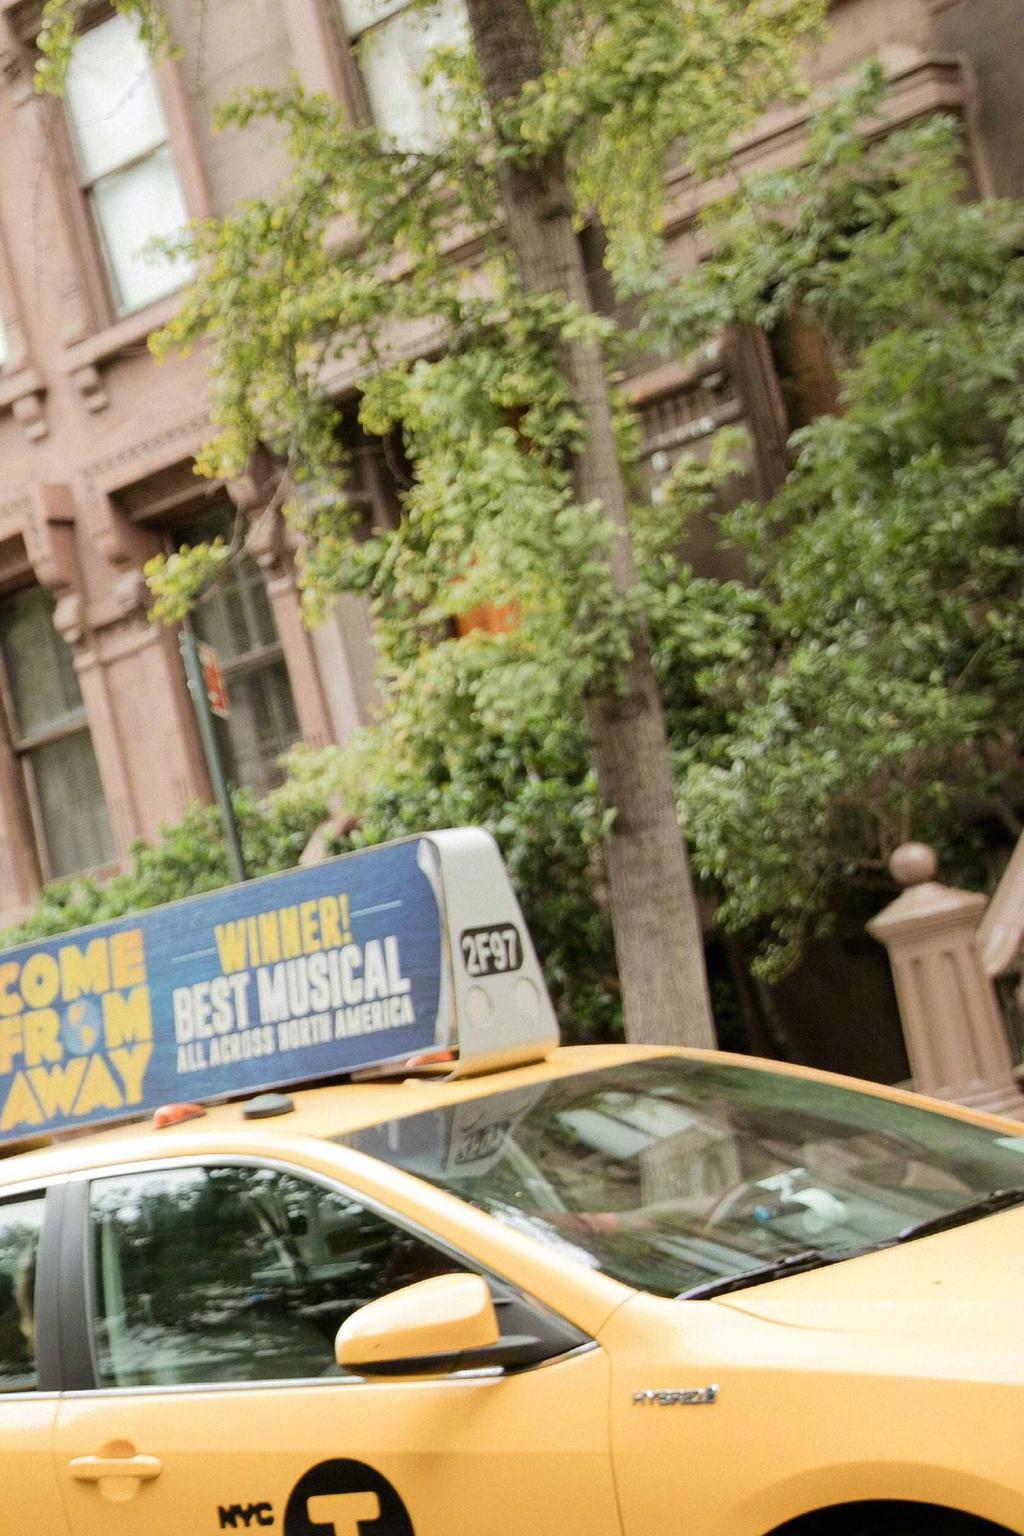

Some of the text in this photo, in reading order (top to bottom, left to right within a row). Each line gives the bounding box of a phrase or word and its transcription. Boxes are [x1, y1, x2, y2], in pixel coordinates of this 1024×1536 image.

[214, 893, 352, 974] WINNER!
[462, 929, 517, 974] 2F97
[172, 935, 411, 1043] BEST MUSICAL
[177, 994, 416, 1074] ALL ACROSS NORTH AMERICA
[217, 1502, 275, 1530] NYC
